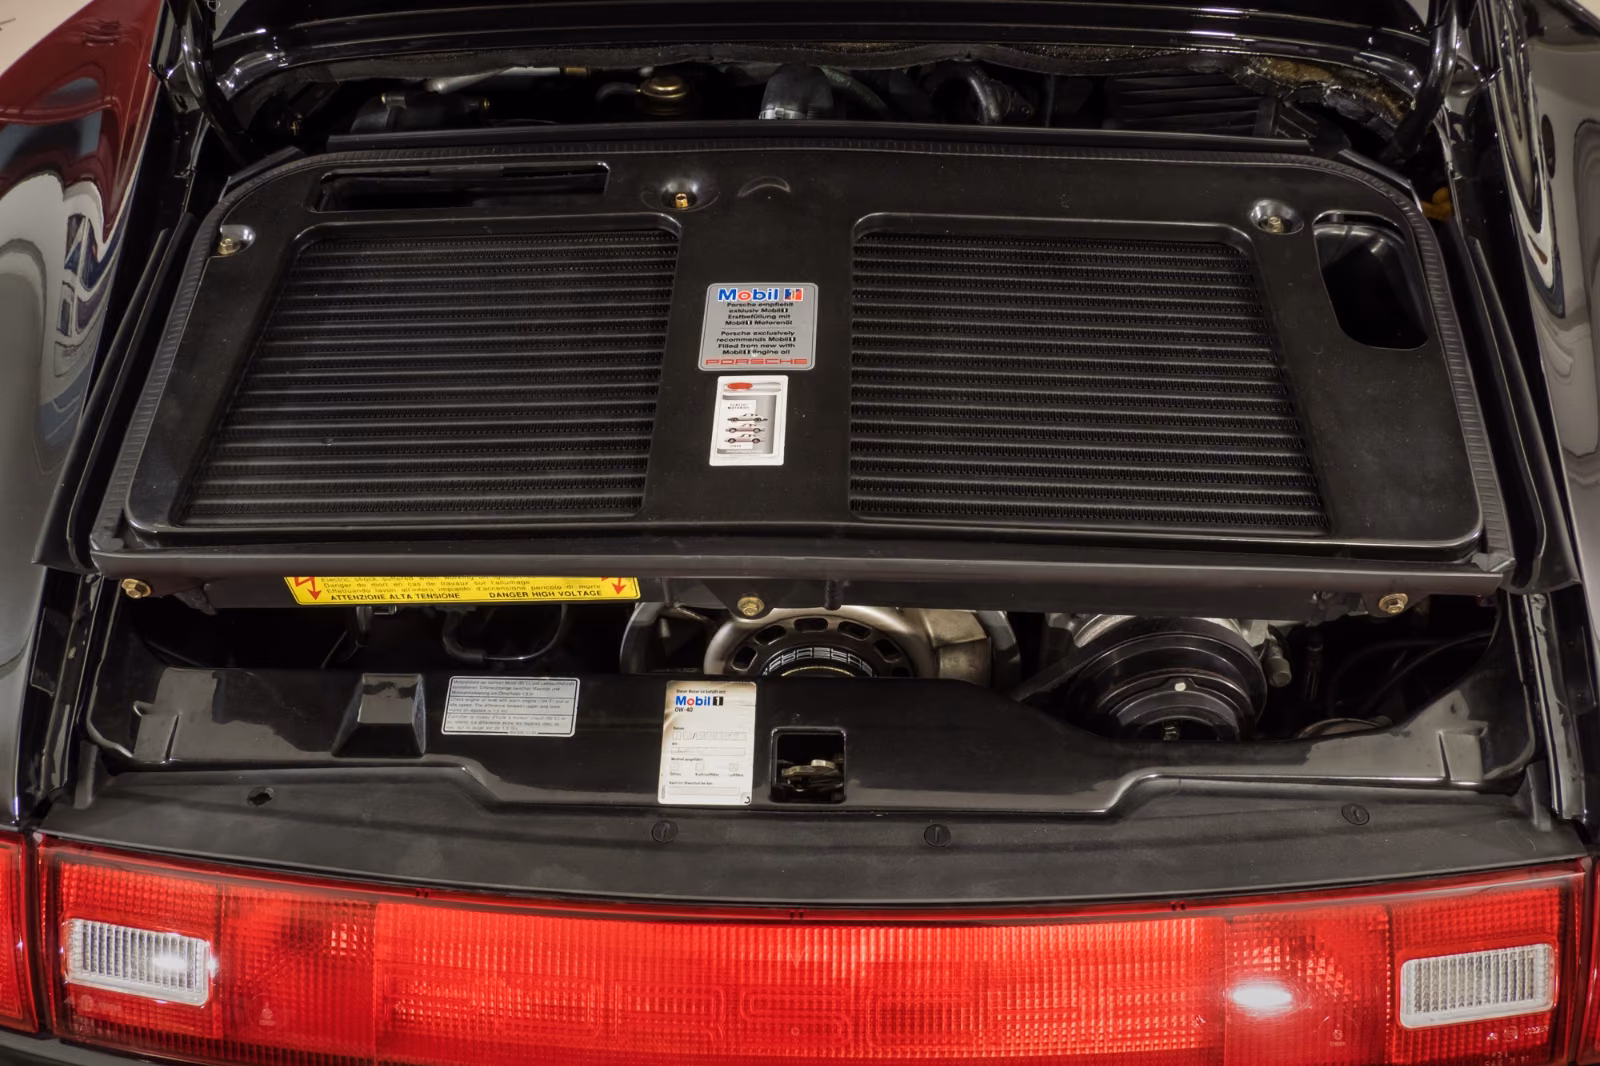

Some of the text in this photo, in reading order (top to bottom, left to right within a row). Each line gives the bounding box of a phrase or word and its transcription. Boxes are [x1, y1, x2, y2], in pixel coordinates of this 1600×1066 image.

[718, 288, 779, 301] Mobil
[675, 695, 724, 706] Mobil 1
